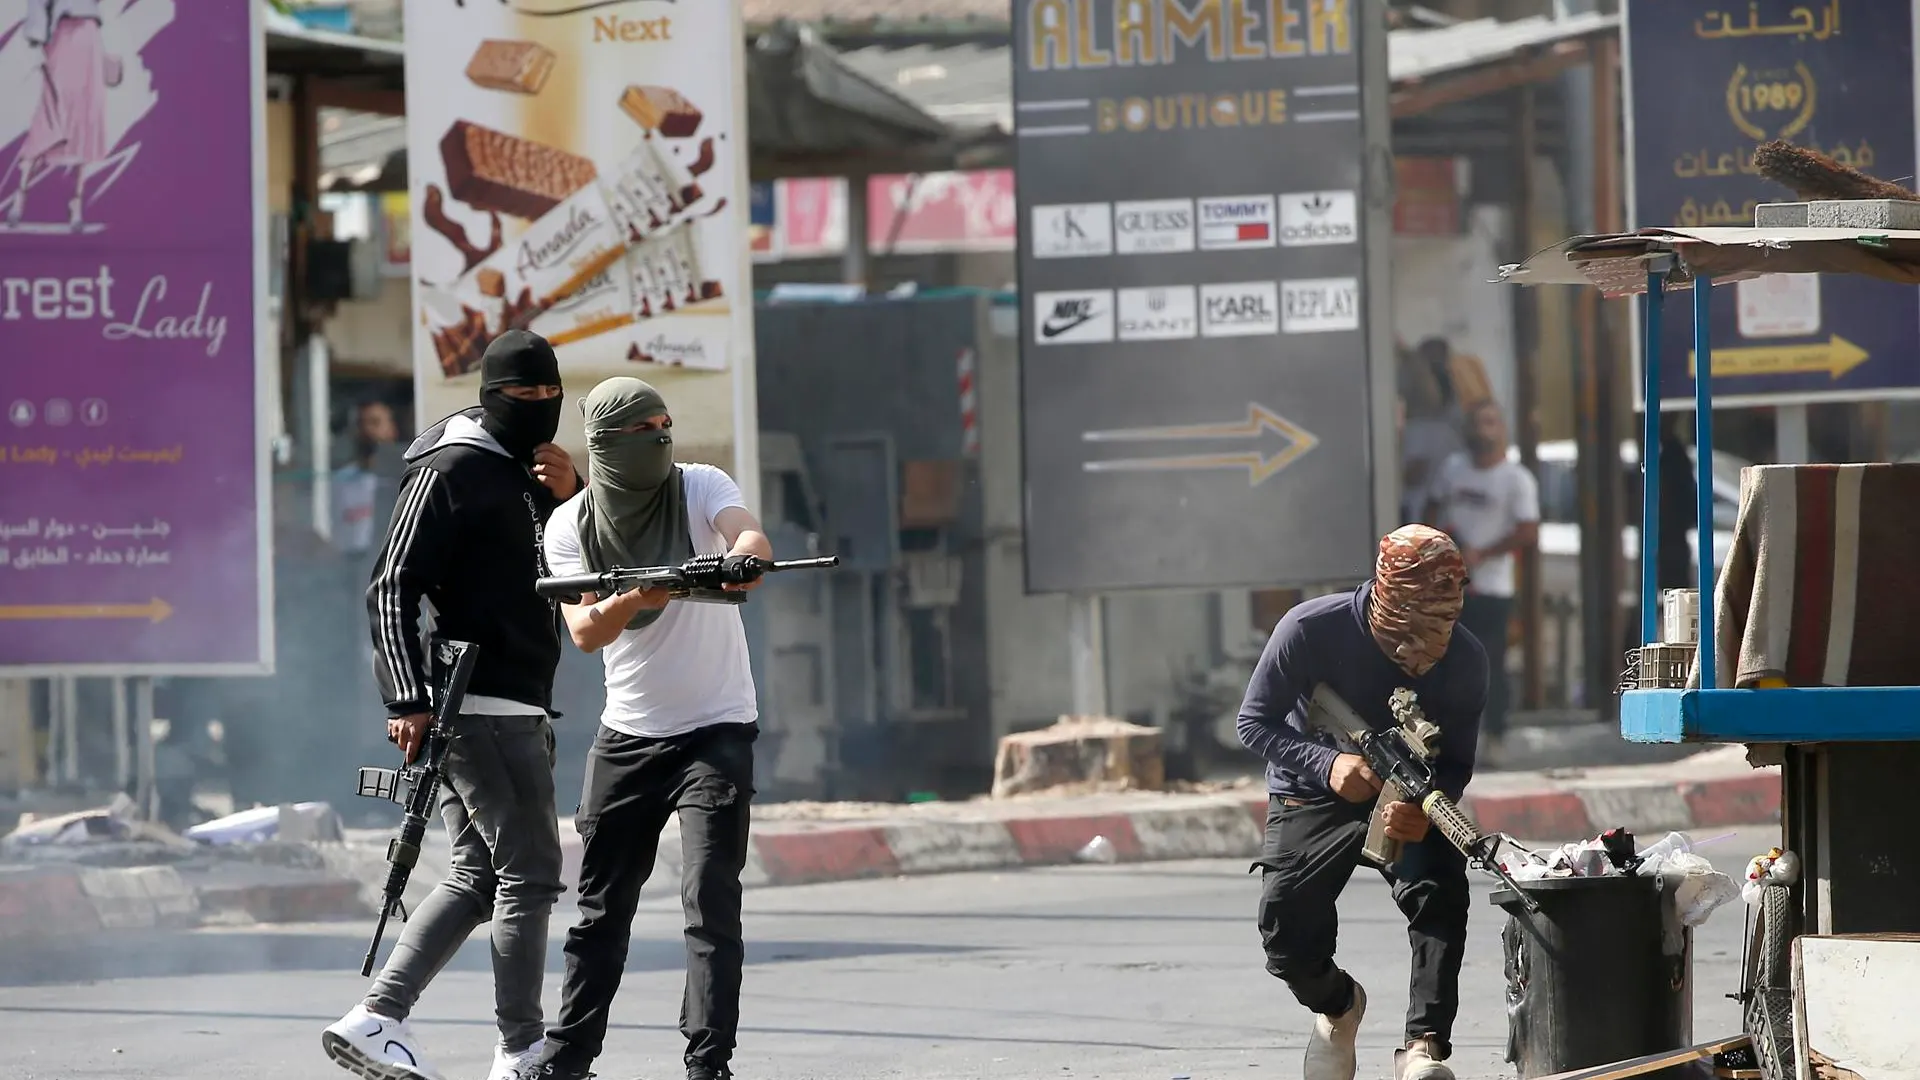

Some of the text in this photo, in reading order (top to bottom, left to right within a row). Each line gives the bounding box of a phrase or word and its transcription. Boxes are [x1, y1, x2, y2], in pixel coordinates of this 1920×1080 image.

[592, 15, 672, 42] Next
[1740, 81, 1802, 112] 1989
[1096, 88, 1287, 133] BOUTIQUE
[1116, 210, 1189, 234] GUESS
[1203, 202, 1269, 219] TOMMY
[1282, 221, 1353, 241] adidas
[0, 265, 227, 357] rest Lady
[1053, 297, 1095, 319] NIKE
[1206, 294, 1270, 318] KARL
[1284, 287, 1354, 320] REPLAY
[523, 492, 539, 521] neo
